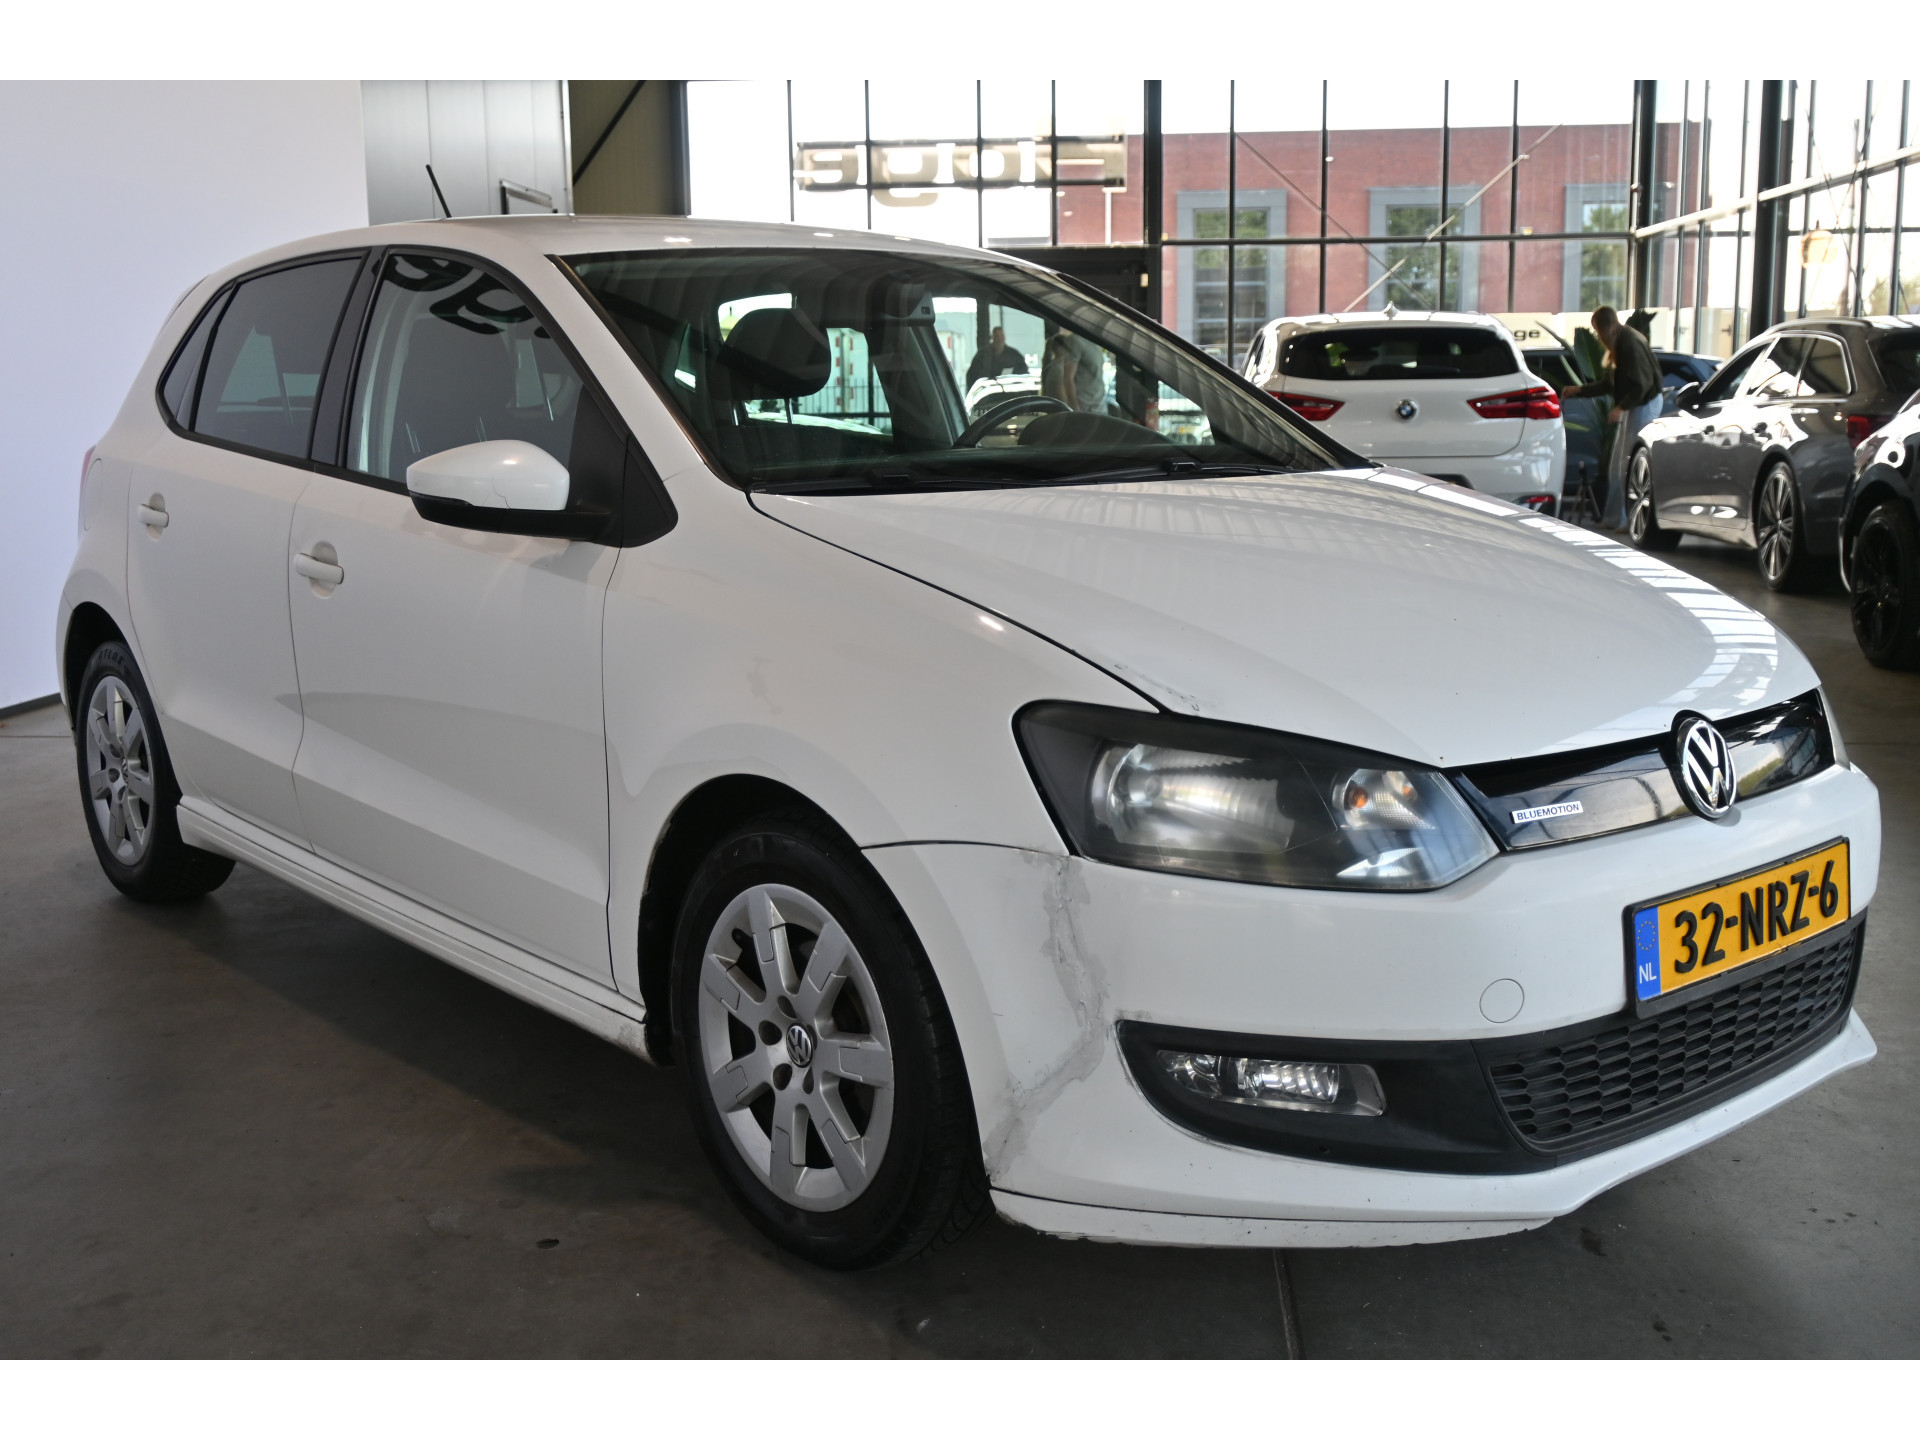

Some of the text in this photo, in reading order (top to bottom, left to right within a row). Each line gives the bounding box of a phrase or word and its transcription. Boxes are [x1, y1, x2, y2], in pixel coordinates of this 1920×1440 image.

[1516, 803, 1580, 821] BLUEMOTION
[1673, 859, 1839, 974] 32-NRZ-6
[1638, 962, 1657, 984] NL
